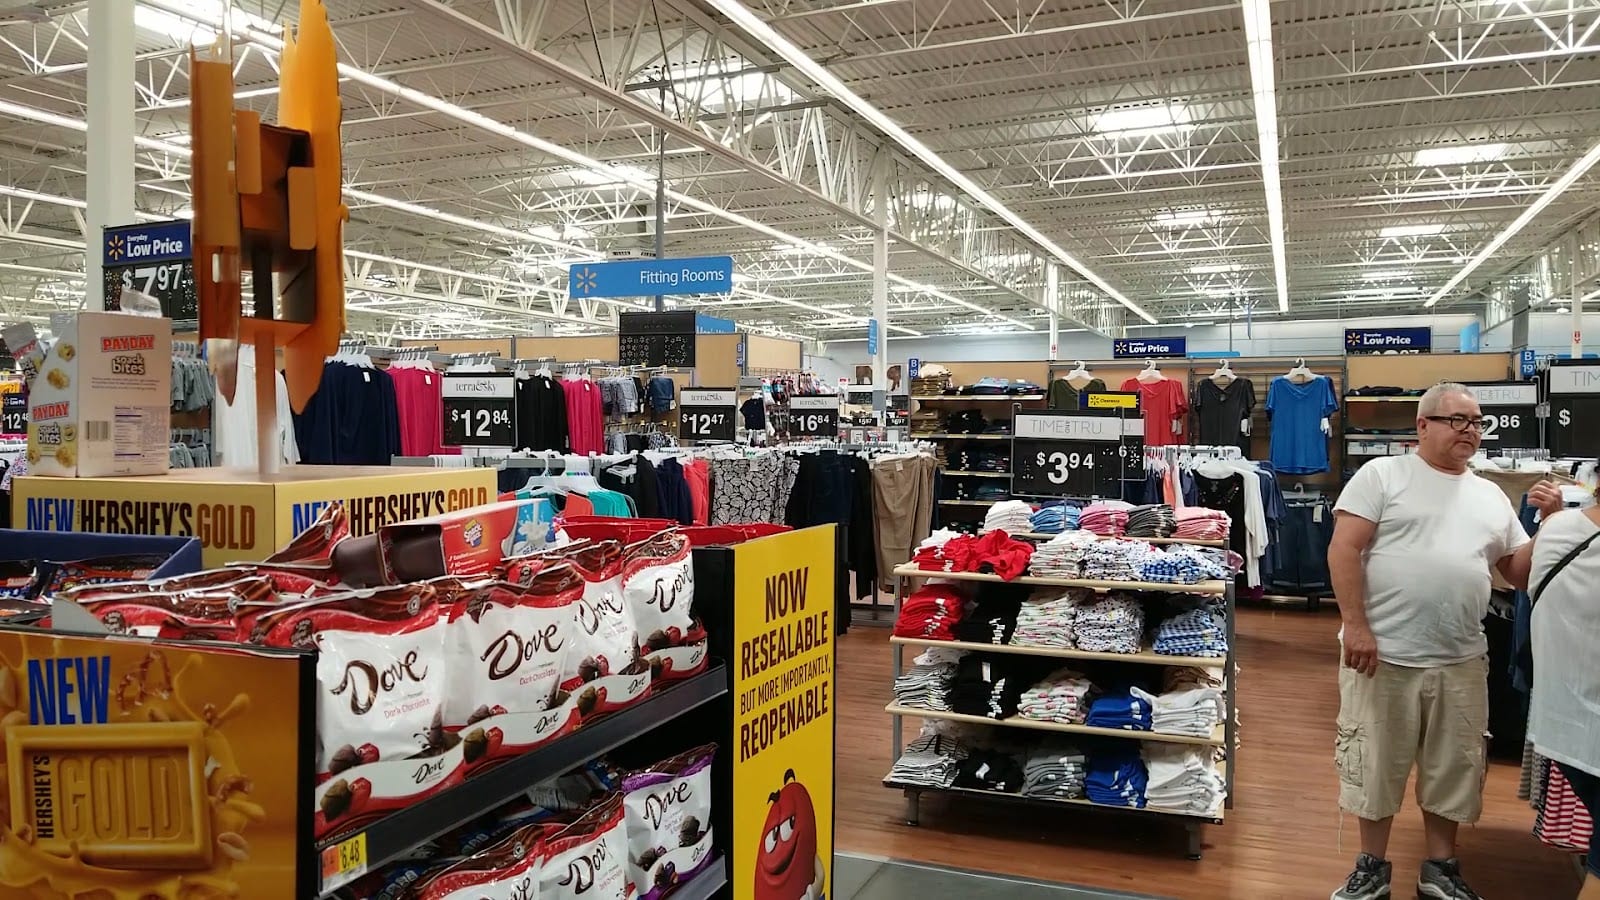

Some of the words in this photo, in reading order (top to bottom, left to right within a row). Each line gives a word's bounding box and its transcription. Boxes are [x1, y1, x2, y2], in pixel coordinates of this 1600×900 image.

[127, 242, 151, 257] Low
[153, 238, 183, 255] Price
[640, 270, 678, 286] Fitting
[681, 268, 725, 282] Rooms
[102, 335, 155, 352] PAYDAY
[1129, 345, 1147, 353] Low
[1148, 344, 1170, 353] Price
[1363, 337, 1384, 345] Low
[1386, 336, 1412, 345] Price
[1524, 351, 1533, 361] B
[112, 359, 145, 375] bites
[1522, 364, 1534, 373] 19
[32, 402, 69, 420] PAYDAY
[1031, 419, 1065, 434] TIME
[1071, 420, 1103, 435] TRU
[27, 497, 75, 532] NEW
[81, 499, 193, 537] HERSHEY'S
[196, 503, 256, 550] GOLD
[350, 489, 445, 537] HERSHEY'S
[765, 566, 809, 624] NOW
[480, 623, 565, 681] Dove
[741, 610, 828, 681] RESEALABLE
[27, 655, 111, 725] NEW
[329, 650, 428, 716] Dove
[519, 674, 534, 686] Dark
[740, 687, 756, 716] BUT
[758, 676, 779, 707] MORE
[780, 653, 831, 695] IMPORTANTLY,
[384, 705, 401, 719] Dark
[740, 680, 829, 764] REOPENABLE
[412, 758, 444, 784] Dove
[33, 754, 55, 839] HERSHEY'S
[57, 755, 184, 843] GOLD
[643, 781, 693, 831] Dove
[557, 839, 613, 895] Dov
